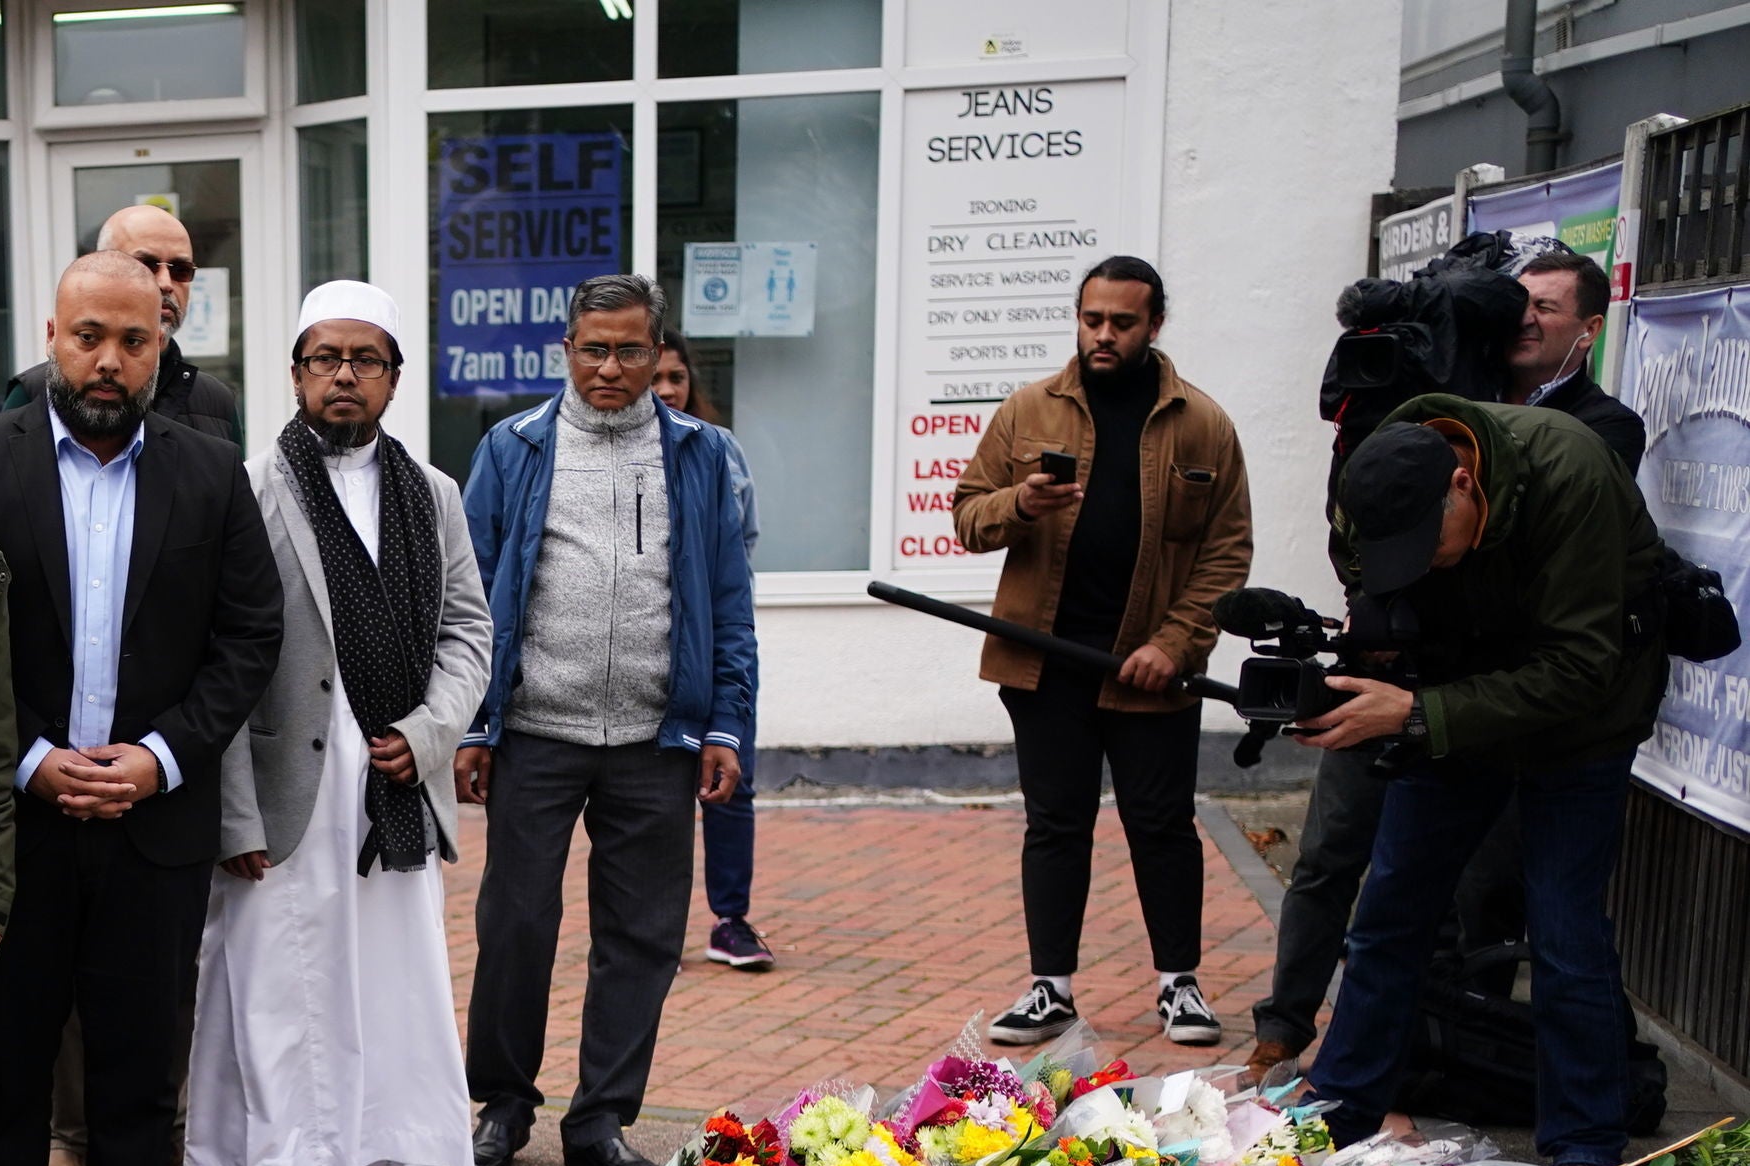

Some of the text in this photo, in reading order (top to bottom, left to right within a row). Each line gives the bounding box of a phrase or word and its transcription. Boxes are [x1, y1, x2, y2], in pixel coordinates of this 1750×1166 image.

[957, 87, 1053, 118] JEANS
[927, 130, 1083, 163] SERVICES
[451, 140, 614, 195] SELF
[968, 198, 1038, 216] IRONING
[449, 207, 613, 260] SERVICE
[927, 228, 1098, 253] DRY CLEANING
[1435, 210, 1450, 246] &
[930, 269, 1072, 289] SERVICE WASHING
[451, 287, 523, 326] OPEN
[927, 306, 1073, 326] DRY ONLY SERVICE
[447, 345, 506, 382] 7am
[512, 344, 540, 380] to
[949, 343, 1049, 362] SPORTS KITS
[943, 382, 992, 397] DUVET
[911, 413, 981, 436] OPEN
[900, 535, 979, 557] CLOS
[1682, 660, 1719, 721] DRY,
[1661, 721, 1710, 778] FROM
